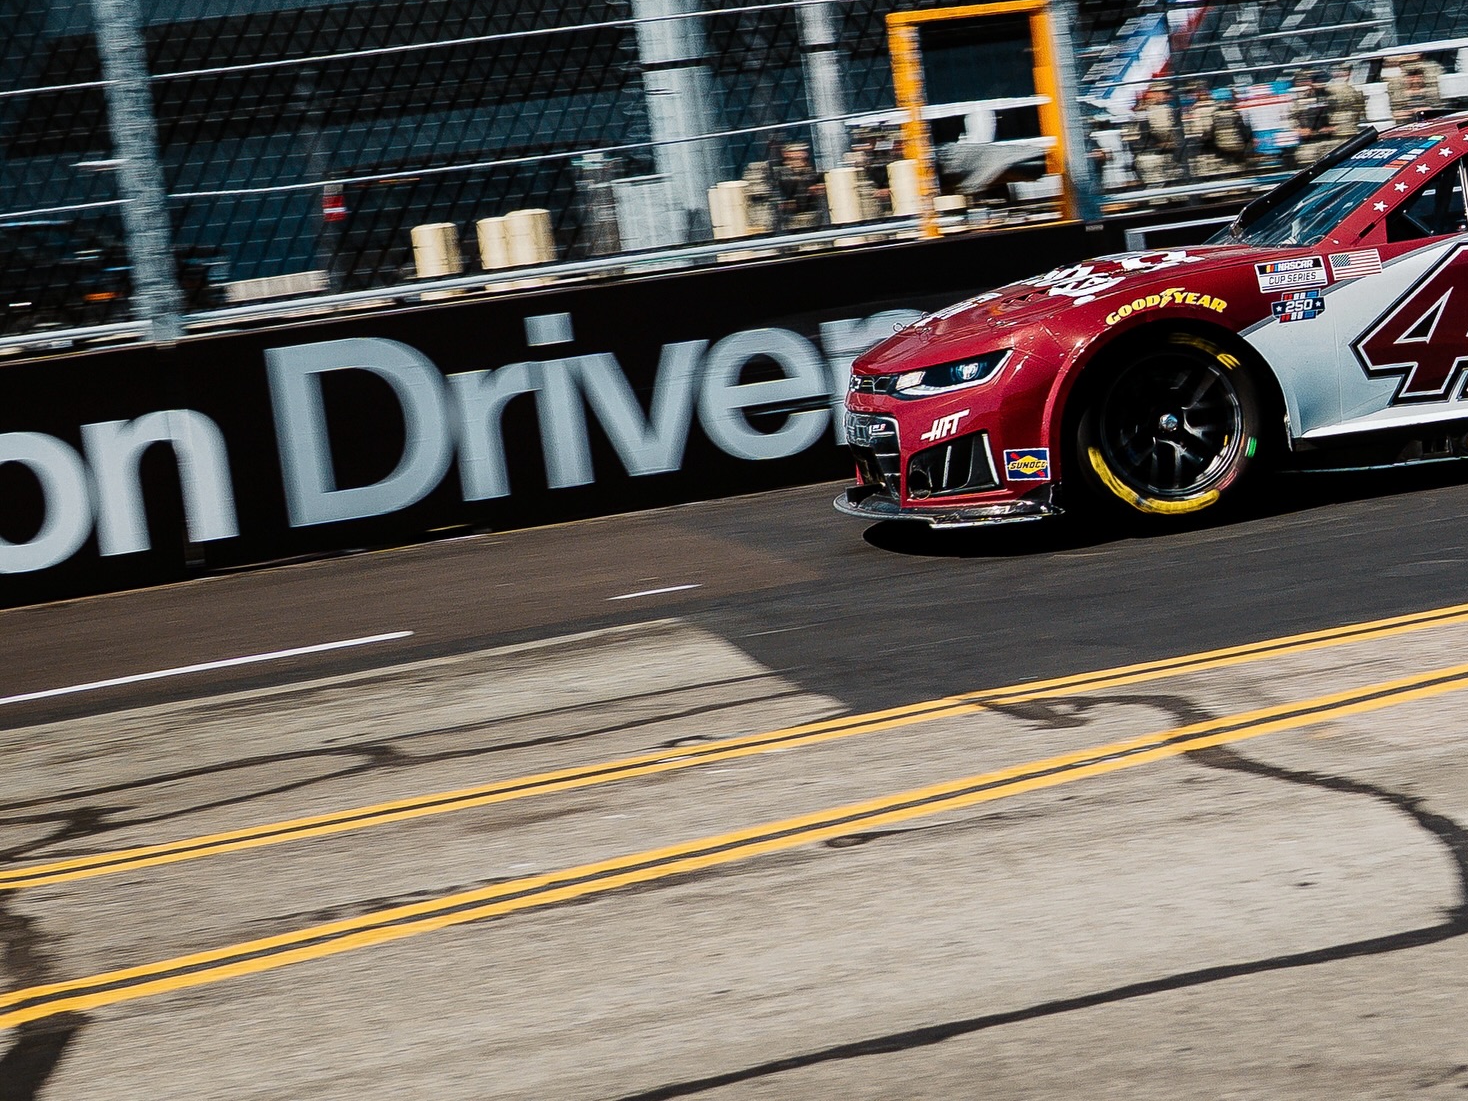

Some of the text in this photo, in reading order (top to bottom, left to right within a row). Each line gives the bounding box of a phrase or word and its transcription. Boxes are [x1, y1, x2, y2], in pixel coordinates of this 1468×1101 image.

[1277, 259, 1314, 272] NASCAR
[1268, 271, 1317, 286] CUP SERIES
[1105, 287, 1228, 326] GOODYEAR
[1285, 299, 1313, 313] 250
[920, 408, 971, 442] HFT
[1010, 459, 1048, 471] SUNOCO
